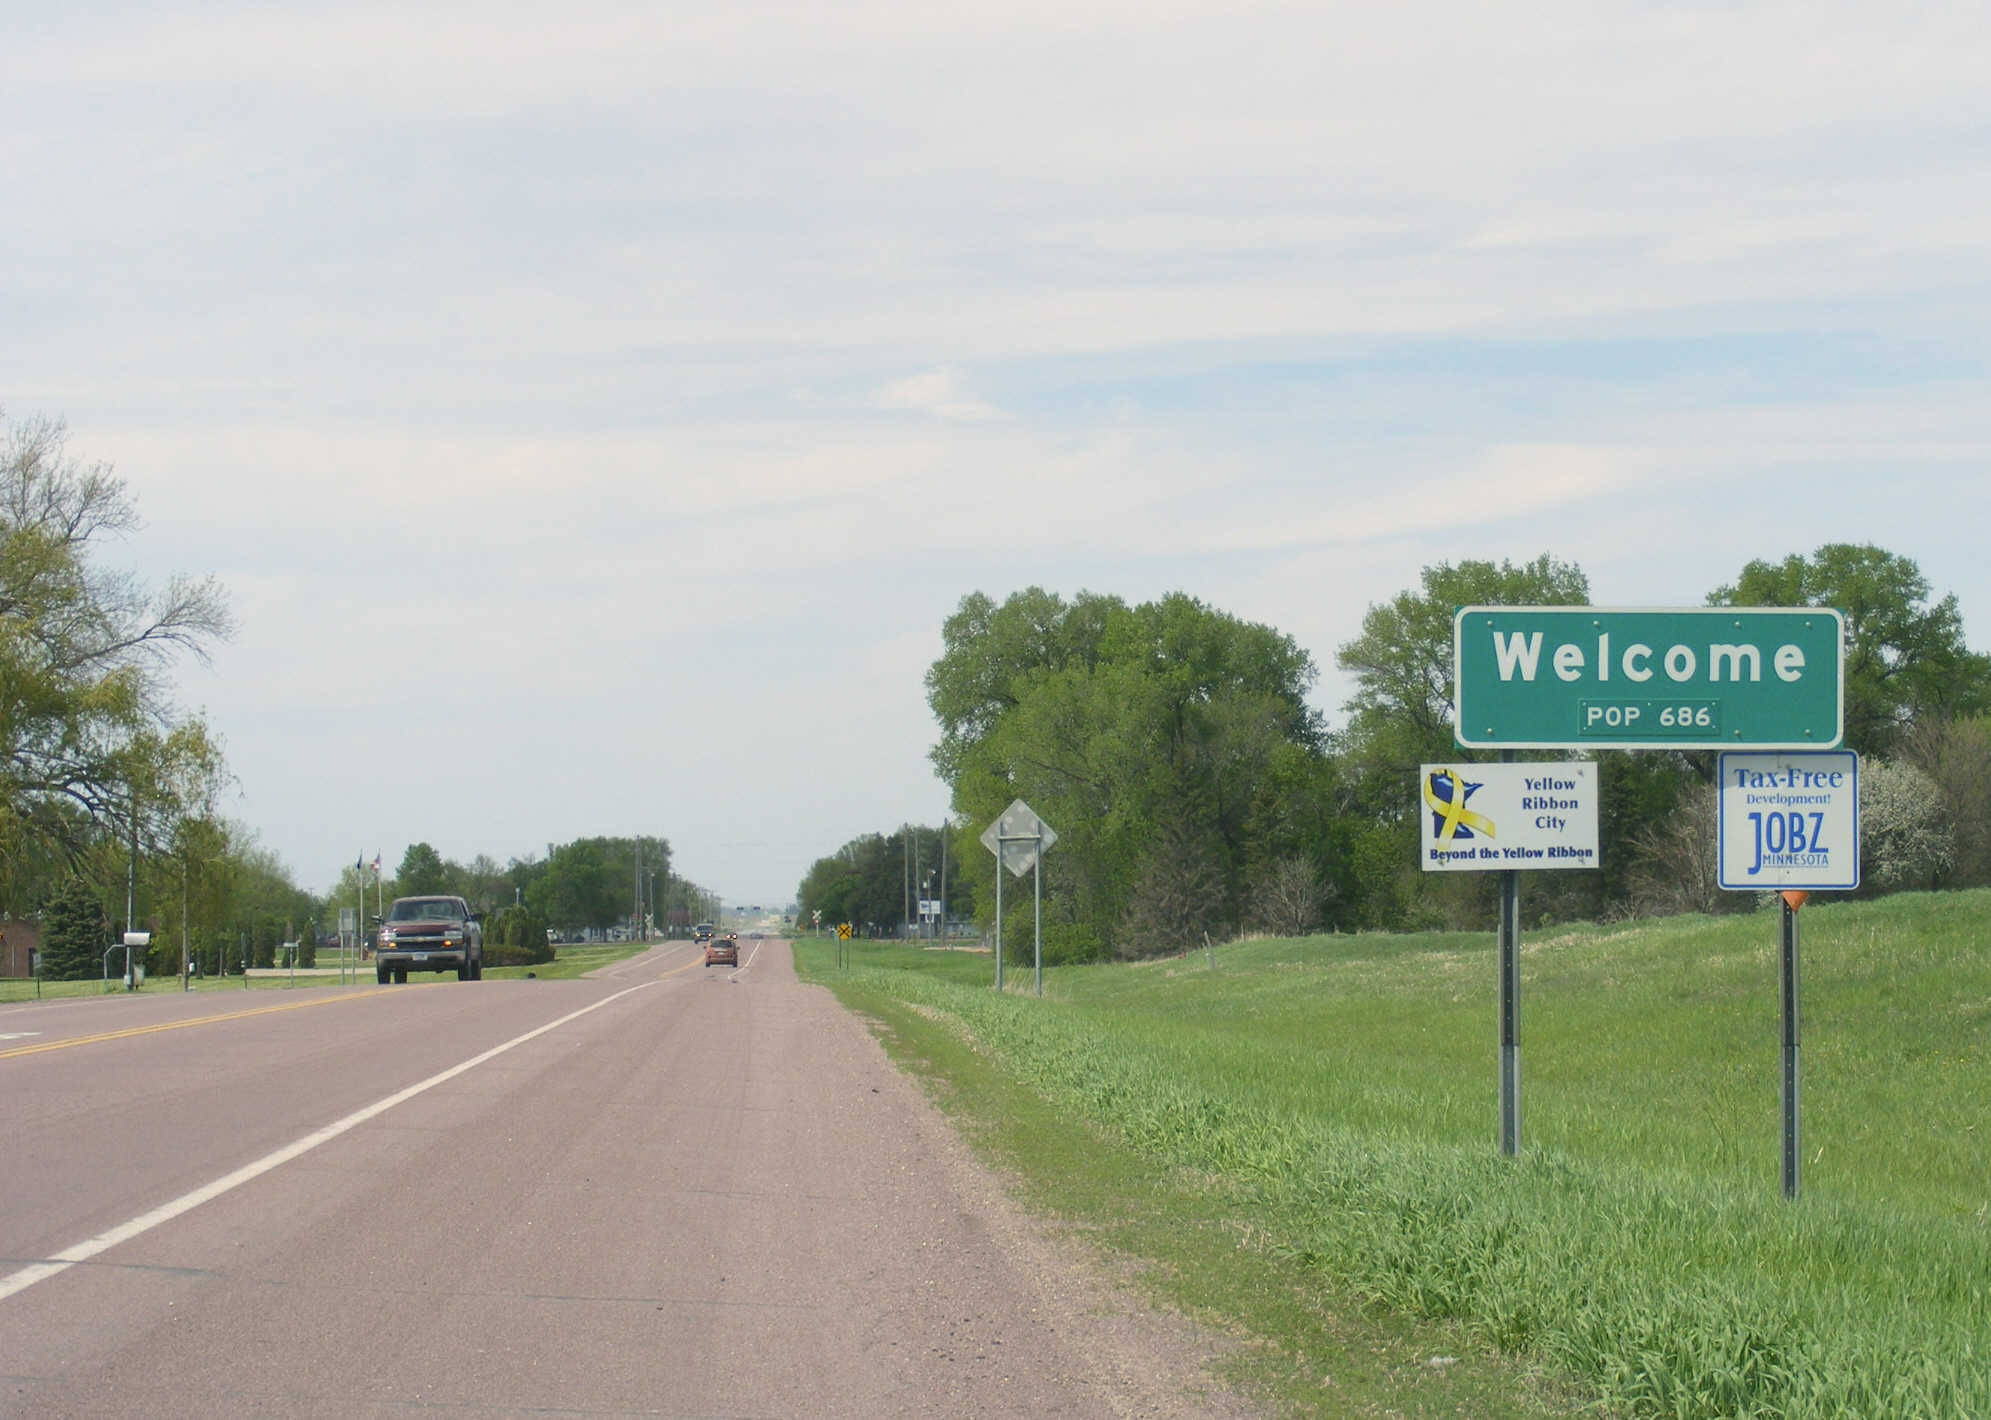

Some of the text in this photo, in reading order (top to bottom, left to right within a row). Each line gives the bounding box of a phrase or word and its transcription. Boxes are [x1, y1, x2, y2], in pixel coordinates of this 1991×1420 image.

[1493, 631, 1806, 682] Welcome
[1587, 706, 1711, 727] POP 686
[1524, 777, 1576, 790] Yellow
[1733, 768, 1843, 789] Tax-Free
[1522, 796, 1578, 810] Ribbon
[1746, 793, 1831, 806] Development!
[1535, 816, 1566, 832] City
[1747, 811, 1829, 875] JOBZ
[1430, 846, 1593, 863] Beyond the Yellow Ribbon
[1762, 854, 1829, 865] MINNESOTA
